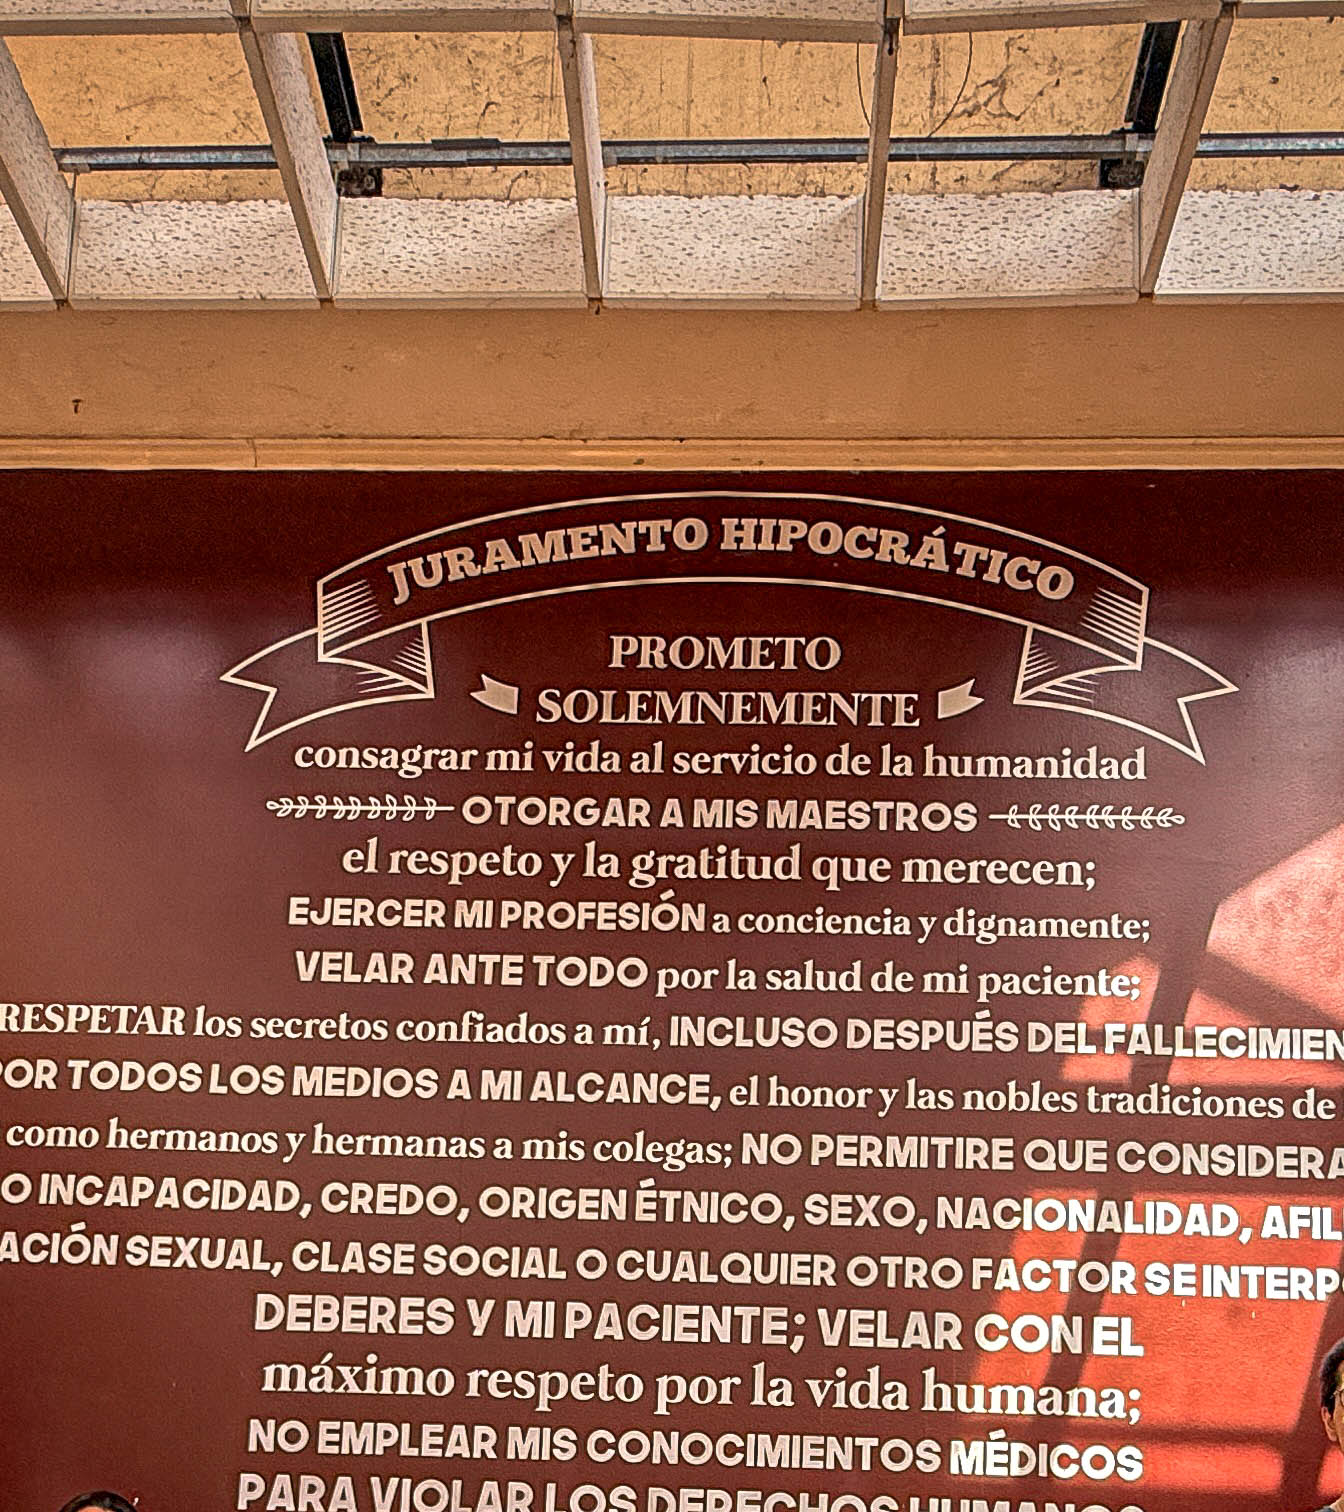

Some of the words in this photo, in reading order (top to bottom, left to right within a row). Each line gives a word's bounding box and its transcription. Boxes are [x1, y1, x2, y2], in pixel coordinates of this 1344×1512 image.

[387, 518, 708, 605] JURAMENTO
[720, 518, 1074, 600] HIPOCRÁTICO
[608, 635, 841, 671] PROMETO
[535, 688, 920, 727] SOLEMNEMENTE
[294, 744, 479, 779] consagrar
[484, 740, 534, 771] mi
[541, 739, 621, 773] vida
[629, 740, 665, 773] al
[672, 743, 817, 775] servicio
[825, 742, 872, 776] de
[879, 742, 914, 777] la
[922, 743, 1148, 780] humanidad
[462, 795, 651, 828] OTORGAR
[659, 798, 684, 828] A
[692, 798, 759, 828] MIS
[766, 799, 978, 832] MAESTROS
[342, 836, 379, 873] el
[387, 844, 543, 886] respeto
[549, 853, 576, 888] y
[582, 840, 621, 878] la
[628, 842, 802, 889] gratitud
[812, 856, 892, 892] que
[901, 858, 1096, 892] merecen;
[288, 896, 446, 928] EJERCER
[454, 899, 494, 929] MI
[500, 888, 706, 932] PROFESIÓN
[711, 913, 731, 933] a
[737, 906, 912, 936] conciencia
[917, 916, 938, 944] y
[943, 906, 1150, 945] dignamente;
[295, 950, 414, 984] VELAR
[423, 953, 524, 986] ANTE
[532, 955, 649, 988] TODO
[655, 968, 720, 998] por
[725, 958, 758, 990] la
[765, 958, 866, 993] salud
[870, 960, 914, 993] de
[922, 963, 970, 994] mi
[976, 964, 1145, 1003] paciente;
[192, 1004, 243, 1038] los
[249, 1012, 389, 1041] secretos
[396, 1010, 567, 1045] confiados
[573, 1023, 594, 1045] a
[602, 1016, 661, 1051] mí,
[669, 1015, 838, 1049] INCLUSO
[846, 1009, 1019, 1052] DESPUÉS
[1027, 1021, 1097, 1054] DEL
[67, 1059, 203, 1093] TODOS
[208, 1063, 285, 1096] LOS
[292, 1065, 439, 1099] MEDIOS
[446, 1069, 472, 1100] A
[480, 1069, 523, 1101] MI
[529, 1070, 722, 1112] ALCANCE,
[729, 1074, 760, 1106] el
[767, 1074, 874, 1108] honor
[877, 1088, 900, 1118] y
[904, 1077, 955, 1110] las
[961, 1079, 1078, 1113] nobles
[1086, 1082, 1285, 1119] tradiciones
[1292, 1087, 1337, 1120] de
[6, 1125, 100, 1148] como
[105, 1116, 279, 1154] hermanos
[282, 1132, 307, 1163] y
[311, 1122, 486, 1159] hermanas
[492, 1137, 514, 1160] a
[521, 1130, 586, 1161] mis
[593, 1129, 733, 1172] colegas;
[741, 1132, 803, 1166] NO
[810, 1133, 1014, 1171] PERMITIRE
[1023, 1138, 1108, 1173] QUE
[0, 1173, 32, 1204] O
[38, 1173, 312, 1219] INCAPACIDAD,
[321, 1182, 470, 1224] CREDO,
[478, 1186, 628, 1221] ORIGEN
[634, 1177, 795, 1232] ÉTNICO,
[804, 1193, 928, 1235] SEXO,
[936, 1196, 1253, 1245] NACIONALIDAD,
[125, 1234, 284, 1278] SEXUAL,
[291, 1240, 416, 1275] CLASE
[422, 1244, 567, 1280] SOCIAL
[576, 1248, 608, 1280] O
[616, 1249, 837, 1287] CUALQUIER
[846, 1255, 964, 1289] OTRO
[971, 1257, 1138, 1295] FACTOR
[1144, 1262, 1197, 1297] SE
[254, 1293, 455, 1335] DEBERES
[466, 1298, 496, 1337] Y
[505, 1300, 556, 1339] MI
[564, 1301, 806, 1354] PACIENTE;
[817, 1308, 964, 1351] VELAR
[974, 1313, 1083, 1354] CON
[1092, 1316, 1145, 1358] EL
[261, 1352, 455, 1397] máximo
[465, 1363, 644, 1412] respeto
[653, 1374, 742, 1416] por
[749, 1361, 795, 1407] la
[804, 1364, 910, 1411] vida
[920, 1366, 1142, 1426] humana;
[248, 1418, 310, 1453] NO
[317, 1420, 498, 1459] EMPLEAR
[506, 1426, 578, 1461] MIS
[586, 1429, 942, 1473] CONOCIMIENTOS
[949, 1428, 1144, 1482] MÉDICOS
